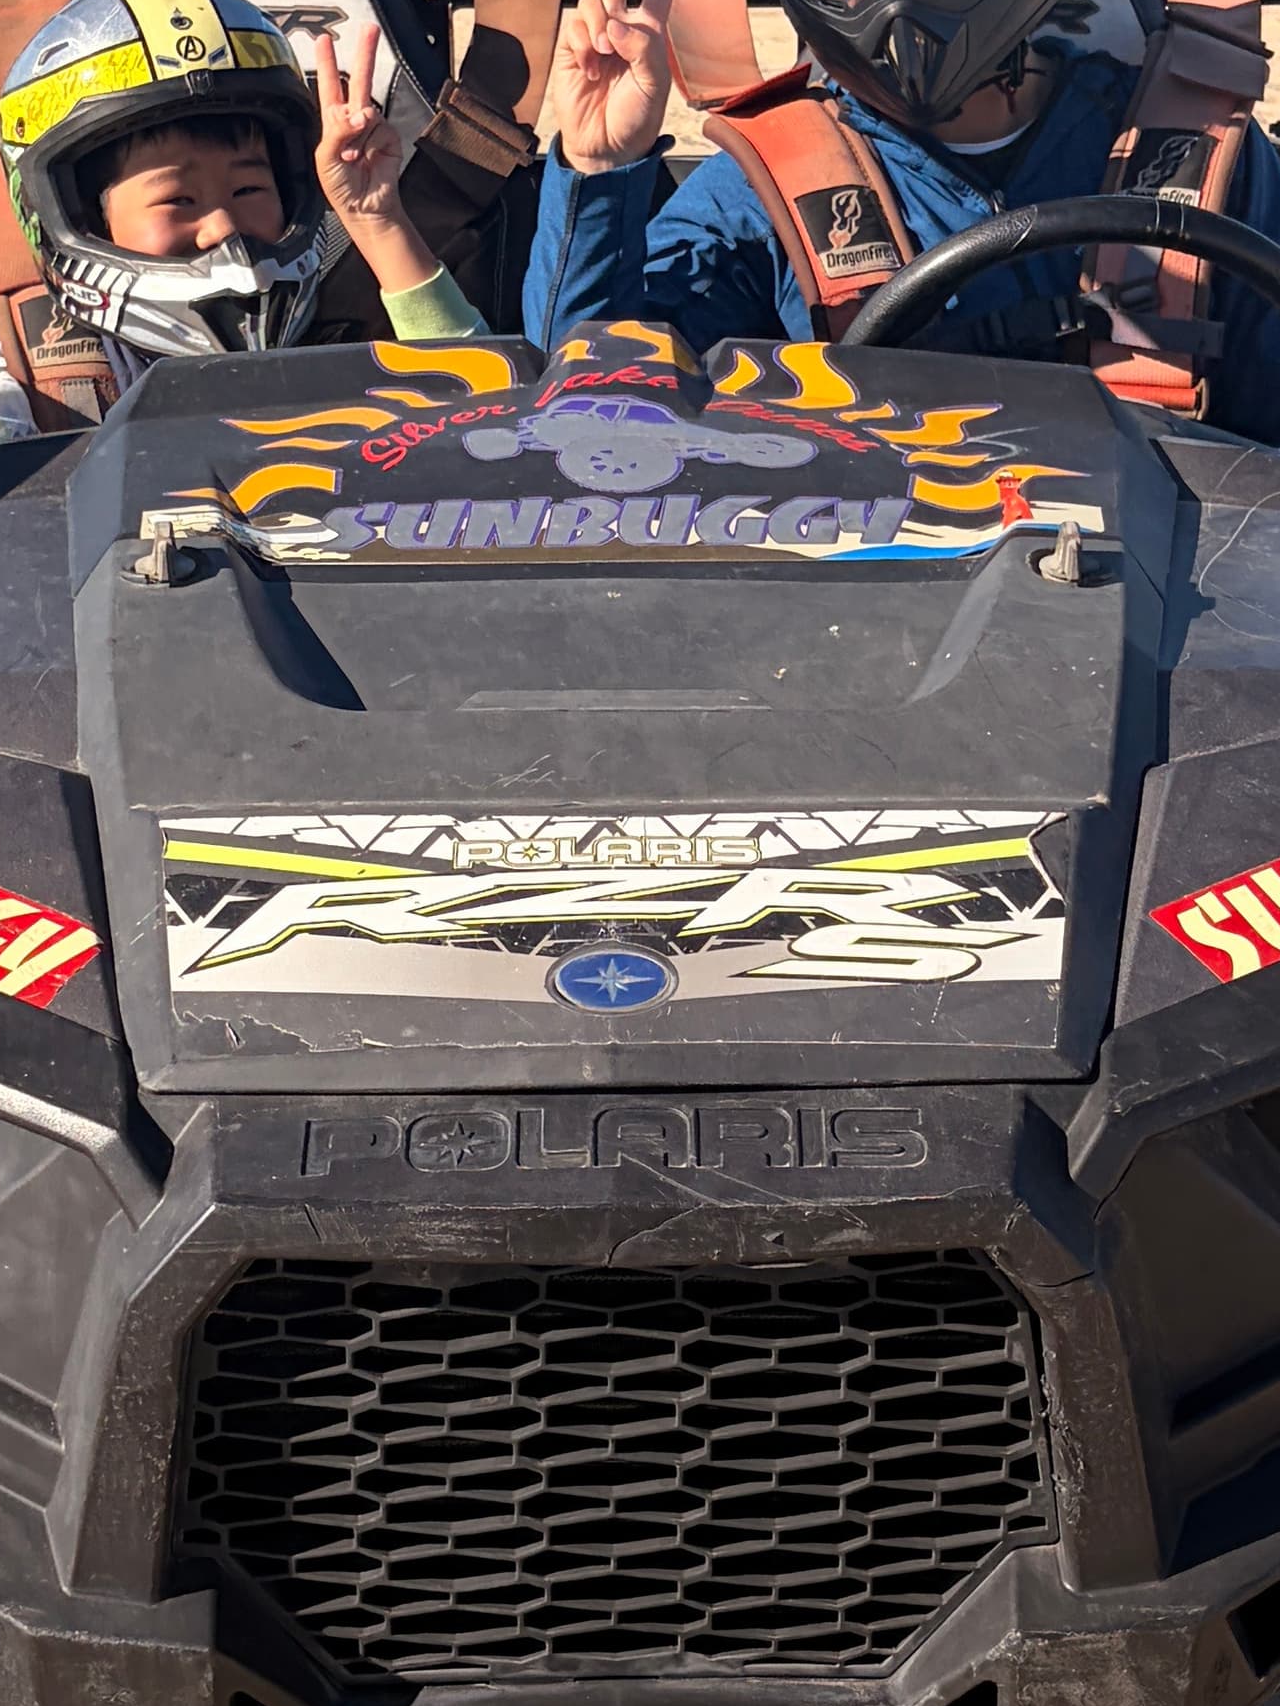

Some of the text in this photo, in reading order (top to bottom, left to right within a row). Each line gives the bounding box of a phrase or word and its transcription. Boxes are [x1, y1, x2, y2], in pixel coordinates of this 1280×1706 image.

[826, 244, 893, 269] DragonFire
[65, 284, 99, 304] HJC
[361, 404, 517, 471] Silver
[320, 496, 915, 550] SUNBUGGY
[453, 836, 762, 870] POLARIS
[182, 867, 984, 976] RZR
[732, 923, 1043, 982] S
[300, 1105, 928, 1178] POLARIS
